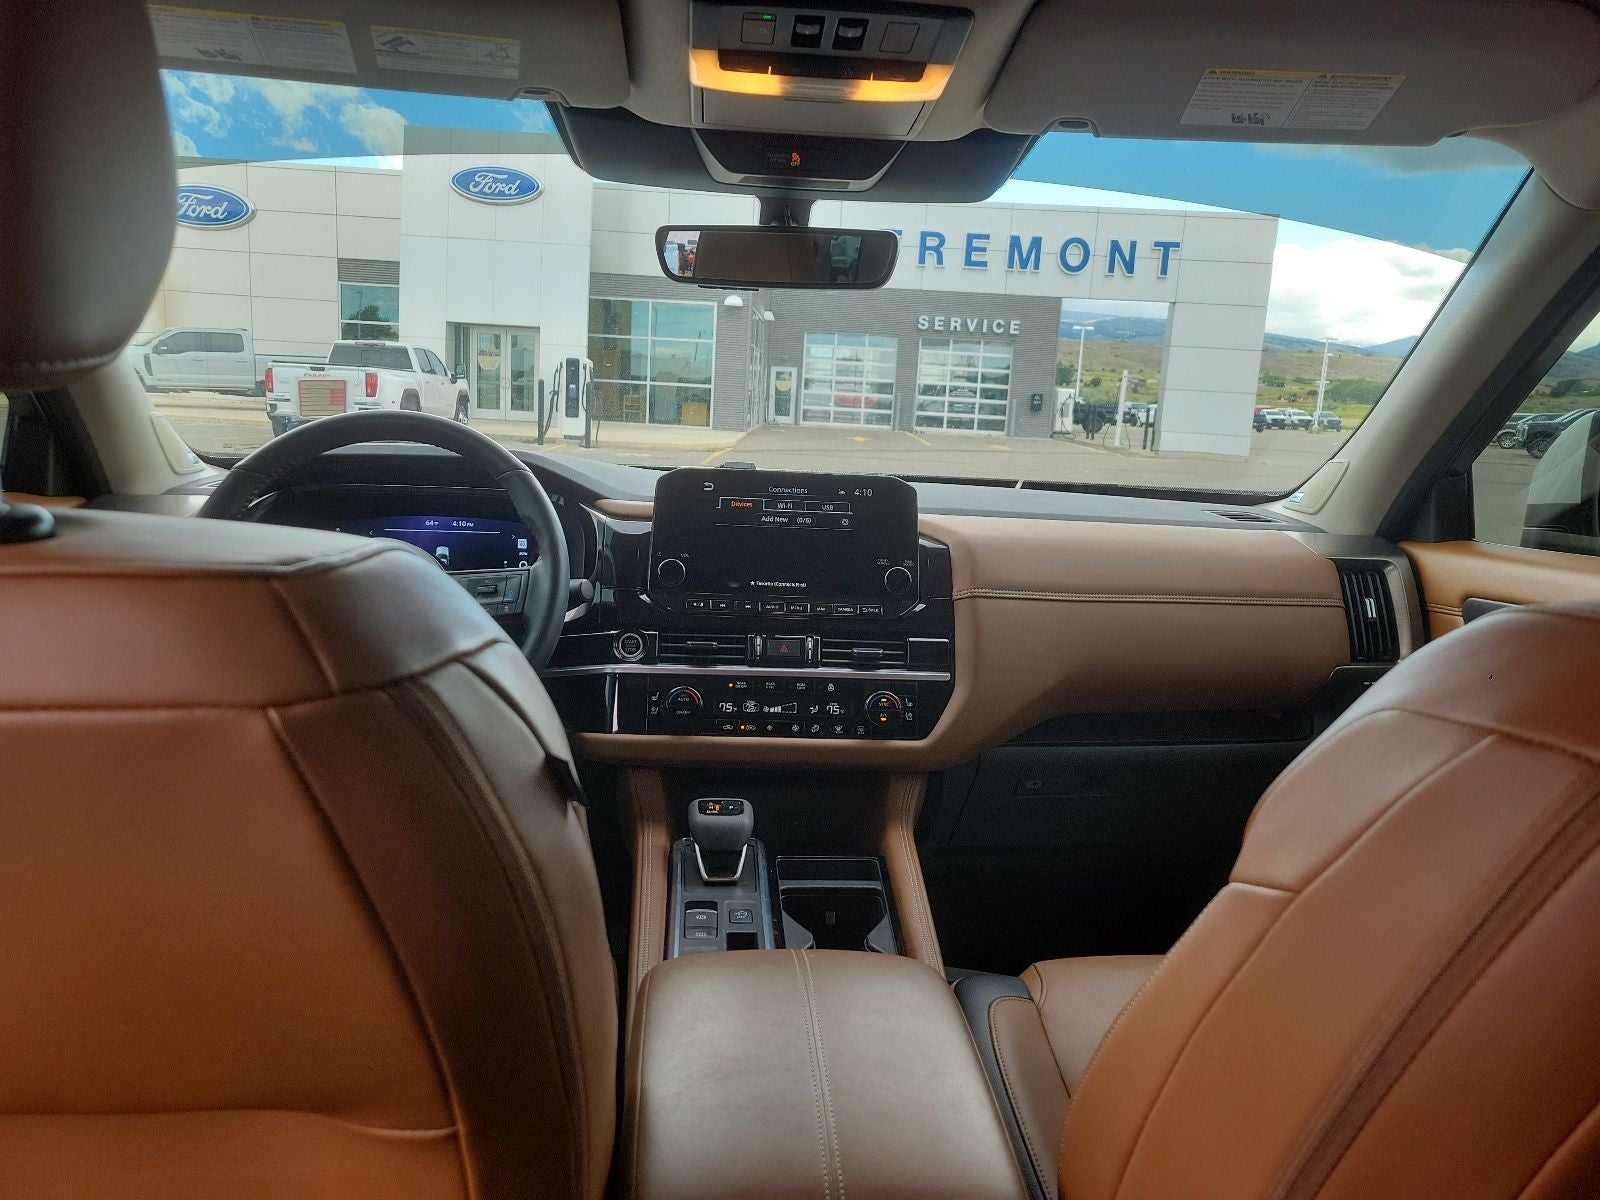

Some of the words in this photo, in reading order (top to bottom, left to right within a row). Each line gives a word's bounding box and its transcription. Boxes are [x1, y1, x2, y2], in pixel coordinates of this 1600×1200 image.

[469, 171, 521, 195] Ford
[177, 192, 228, 219] Ford
[886, 229, 1182, 278] REMONT
[917, 314, 1022, 335] SERVICE
[768, 485, 808, 494] Connections
[854, 488, 873, 497] 4:10
